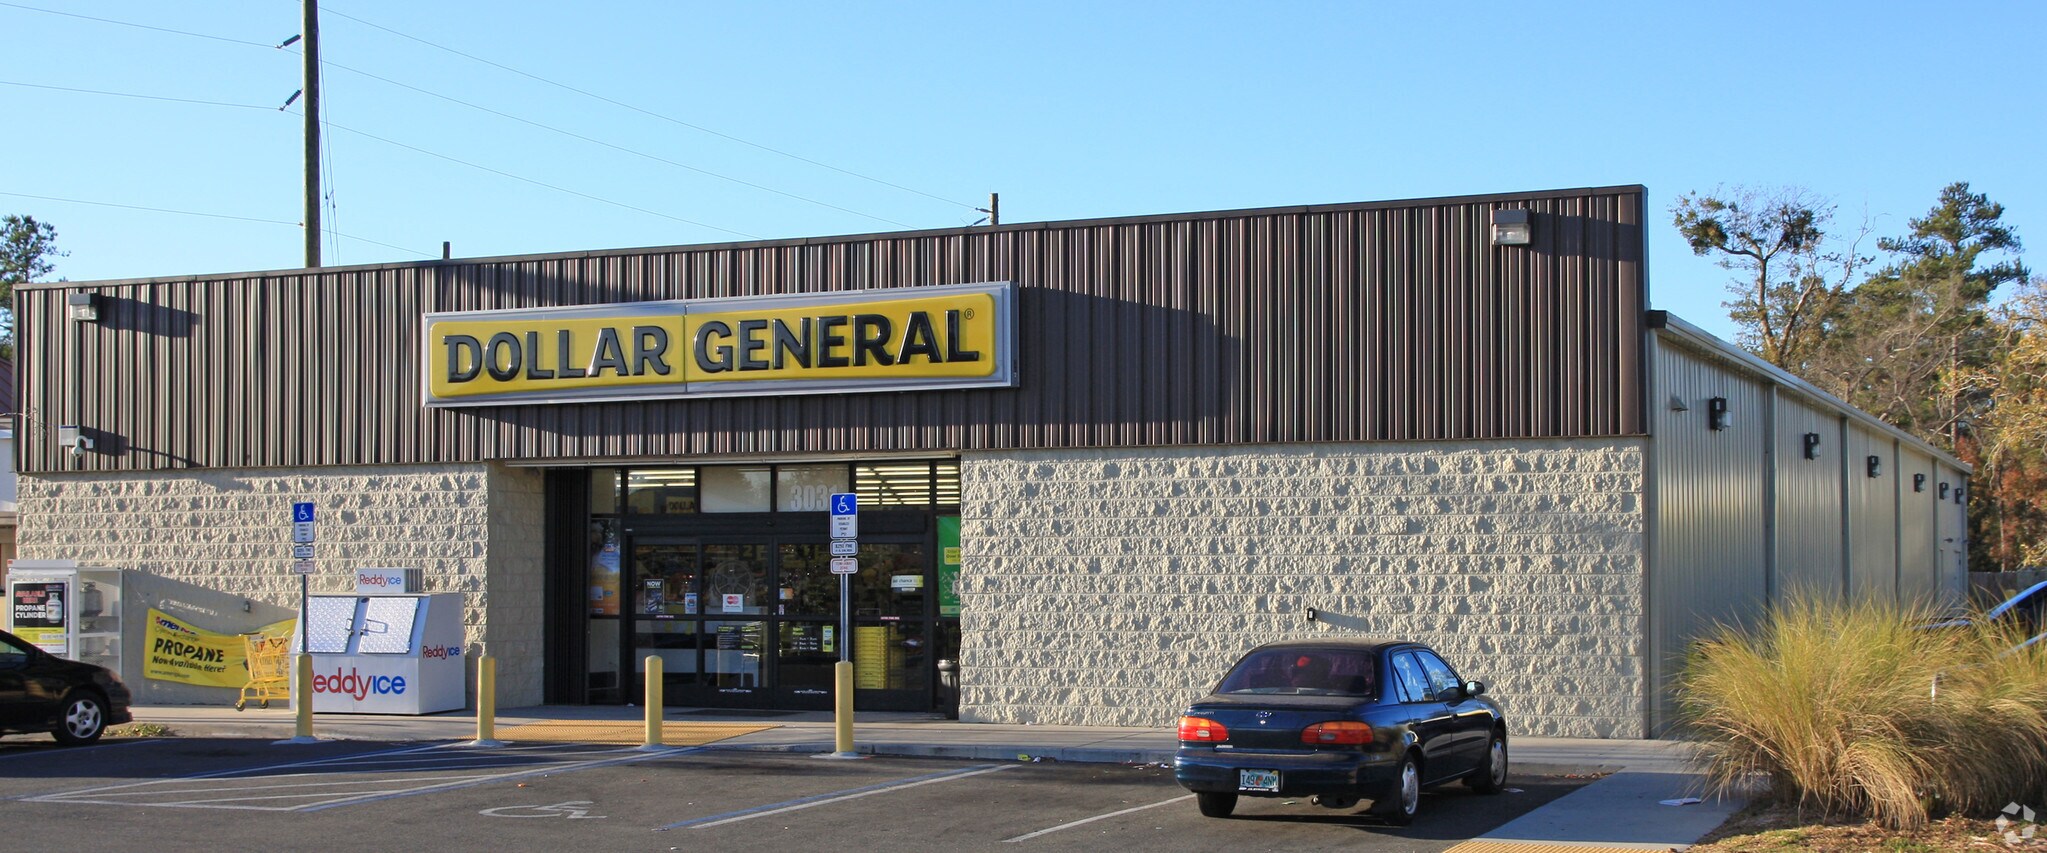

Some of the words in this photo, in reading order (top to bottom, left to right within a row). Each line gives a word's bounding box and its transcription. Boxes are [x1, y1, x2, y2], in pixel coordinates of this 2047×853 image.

[443, 325, 671, 383] DOLLAR
[695, 309, 979, 374] GENERAL
[153, 637, 224, 663] PROPANE
